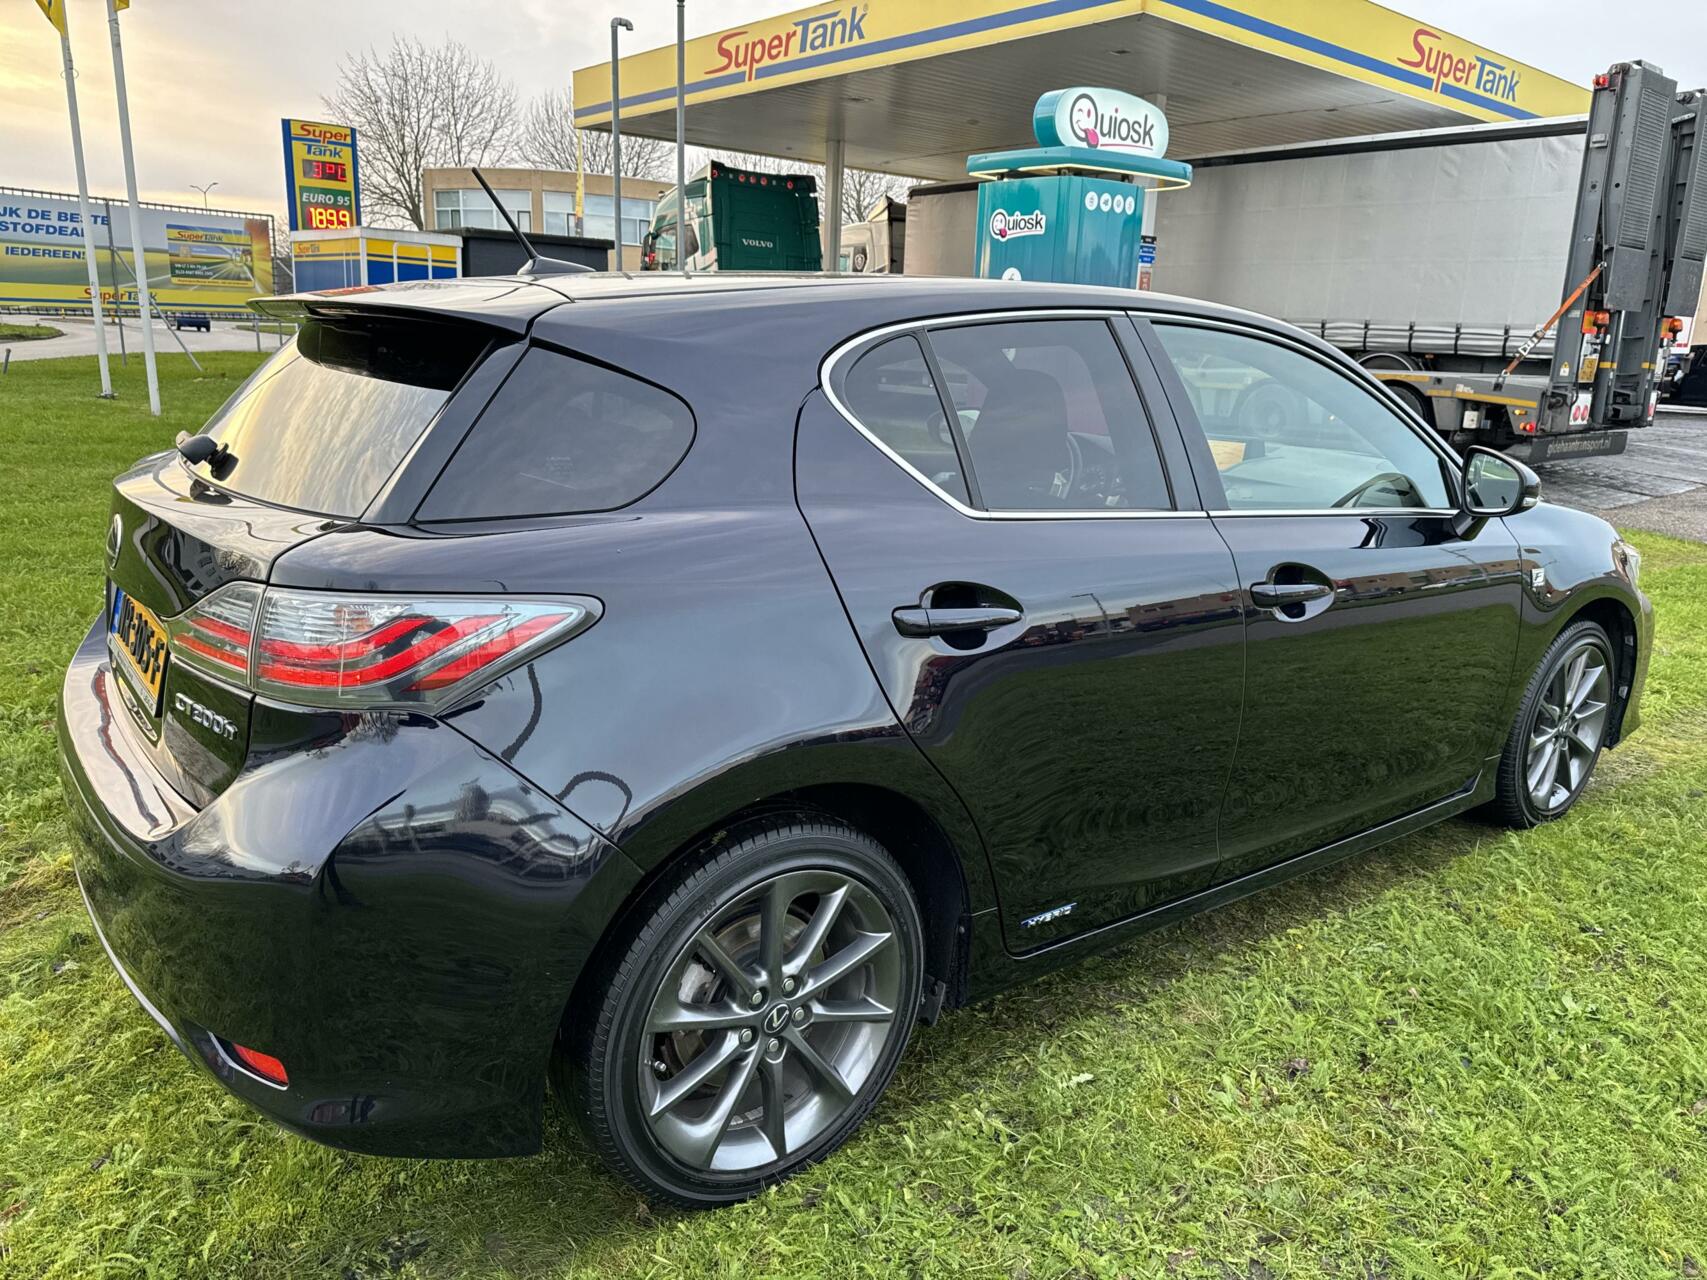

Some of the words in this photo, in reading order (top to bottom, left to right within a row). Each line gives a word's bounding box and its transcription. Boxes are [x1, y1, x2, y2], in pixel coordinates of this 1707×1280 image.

[704, 6, 868, 82] SuperTank
[1397, 28, 1520, 102] SuperTank
[1070, 93, 1154, 149] Quiosk
[300, 123, 350, 144] Super
[302, 143, 343, 159] Tank
[302, 192, 334, 205] EURO
[337, 196, 350, 206] 95
[27, 208, 51, 221] DE
[991, 211, 1043, 238] Quiosk
[742, 238, 774, 249] VOLVO
[5, 246, 86, 260] IEDEREEN!
